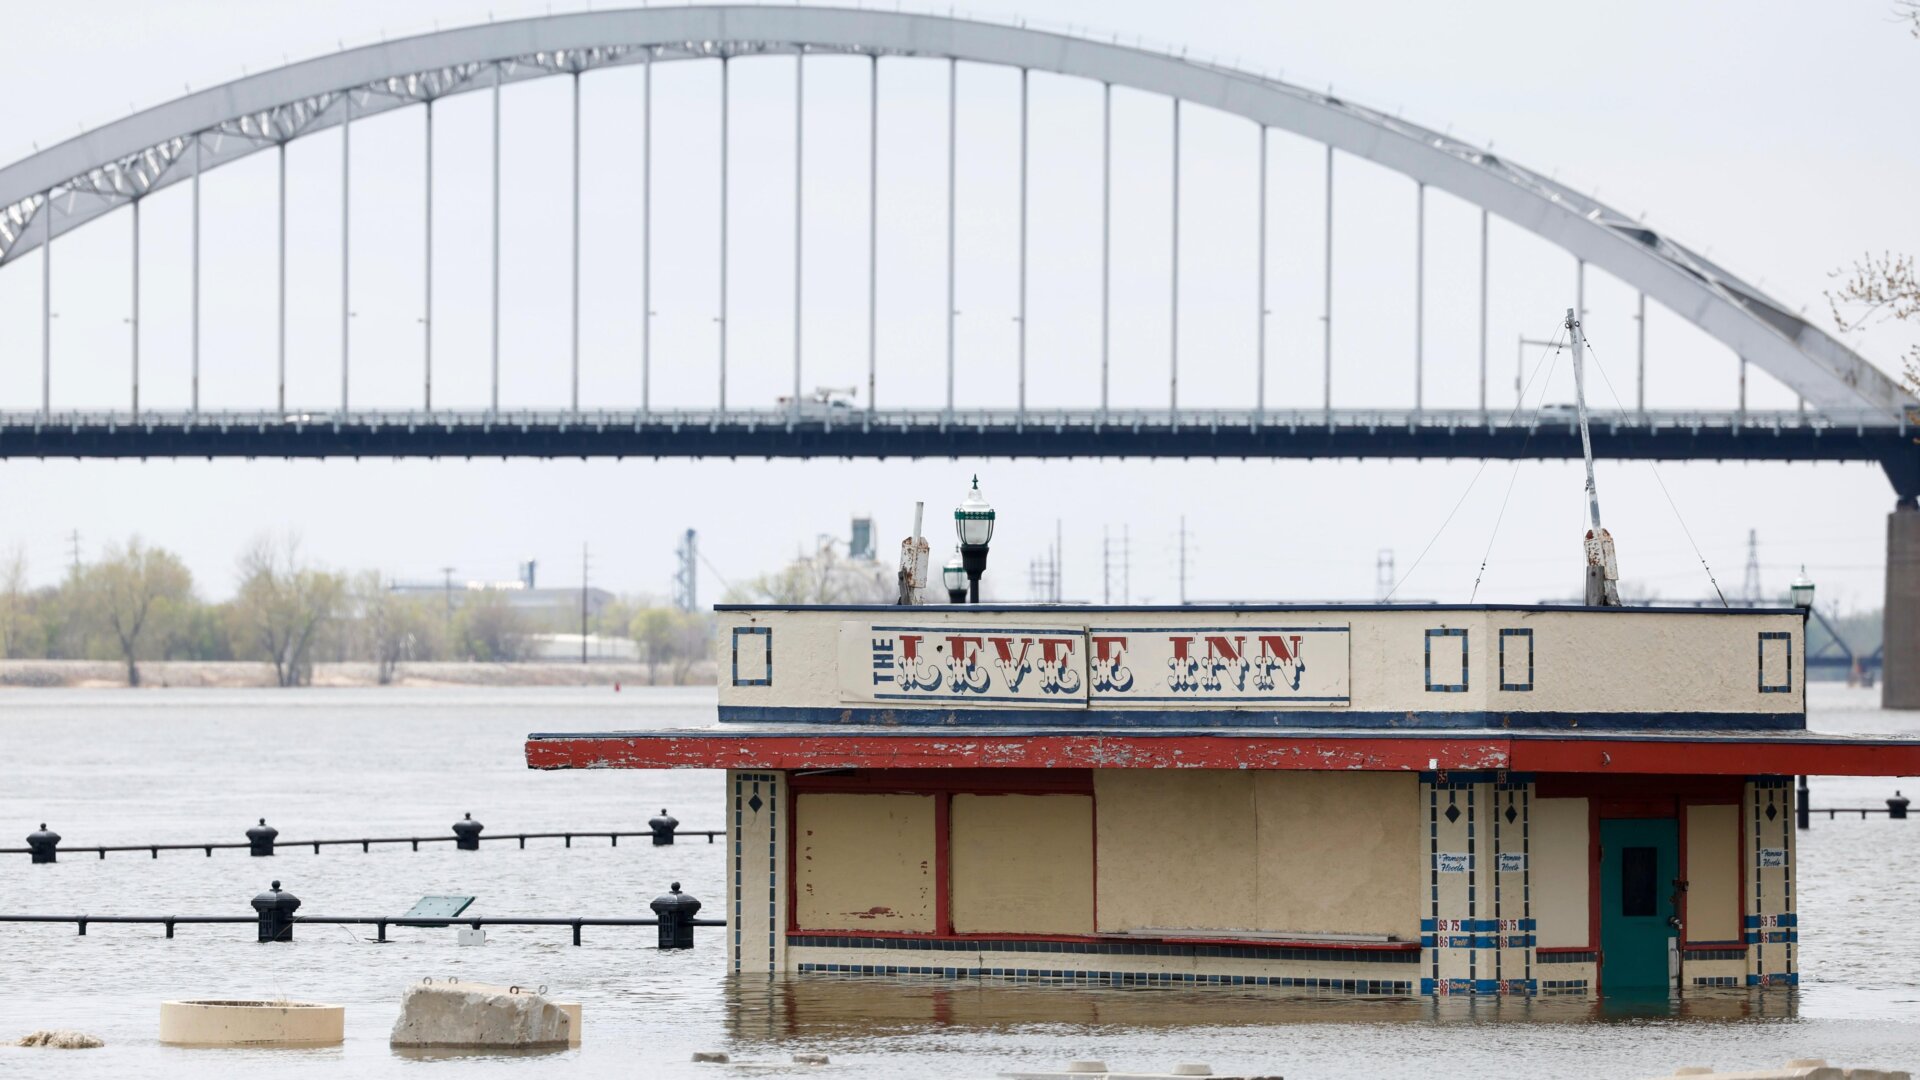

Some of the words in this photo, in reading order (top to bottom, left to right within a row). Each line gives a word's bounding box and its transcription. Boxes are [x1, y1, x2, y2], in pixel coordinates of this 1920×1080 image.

[872, 638, 895, 685] THE
[897, 635, 1134, 695] LEVEE
[1167, 635, 1306, 692] INN
[1438, 919, 1448, 931] 69
[1451, 919, 1460, 931] 75
[1500, 919, 1508, 931] 69
[1509, 919, 1517, 931] 75
[1769, 916, 1777, 927] 75
[1439, 936, 1449, 948] 86
[1439, 978, 1449, 991] 86
[1500, 979, 1509, 991] 86
